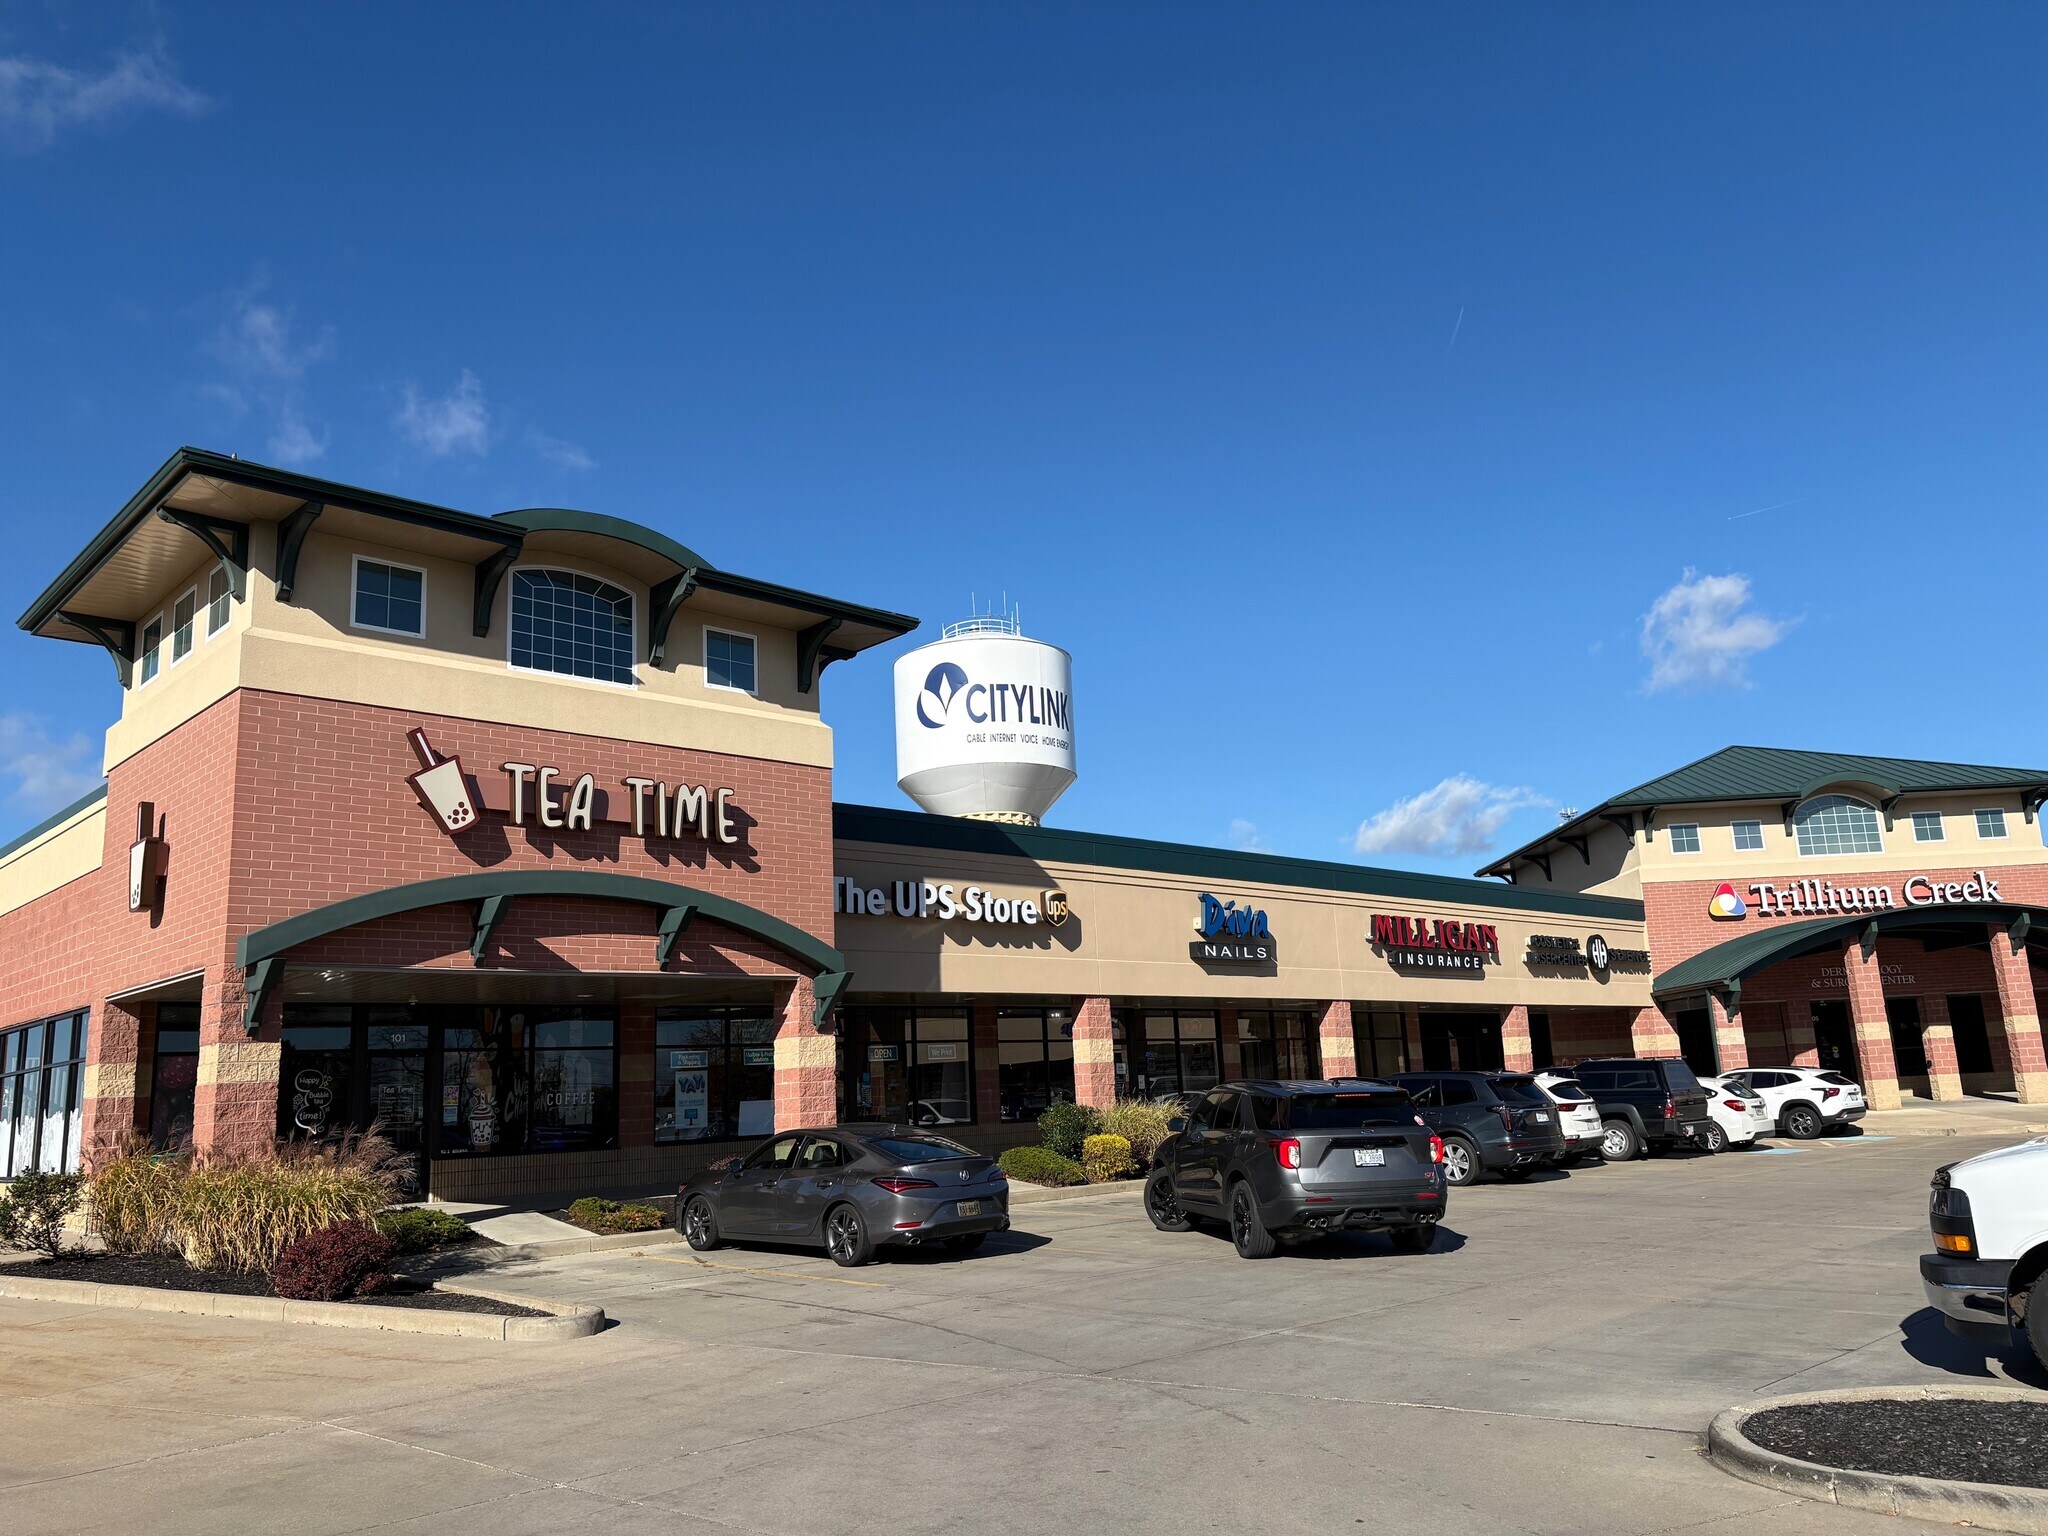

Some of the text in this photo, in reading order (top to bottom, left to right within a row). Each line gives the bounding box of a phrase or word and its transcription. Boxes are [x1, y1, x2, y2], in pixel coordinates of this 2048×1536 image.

[966, 684, 1070, 732] CITYLINK
[966, 733, 986, 744] CABLE
[989, 733, 1017, 743] INTERNET
[1020, 734, 1038, 745] VOICE
[1042, 736, 1056, 748] HOME
[500, 761, 739, 844] TEA TIME
[1750, 871, 2004, 914] Trillium Creek
[833, 876, 1067, 925] The UPS Store ups
[1199, 892, 1269, 941] Diva
[1370, 914, 1500, 953] MILLIGAN
[1204, 945, 1268, 959] NAILS
[1398, 953, 1481, 969] INSURANCE
[1811, 978, 1821, 988] &
[391, 1034, 406, 1043] 101
[874, 1049, 892, 1058] OPEN
[941, 1048, 953, 1056] Print
[299, 1077, 320, 1085] Happy
[678, 1074, 706, 1094] YAY!
[309, 1091, 329, 1099] Bubble
[382, 1086, 414, 1094] Tea Time
[546, 1092, 595, 1106] COFFEE
[299, 1111, 322, 1120] time!
